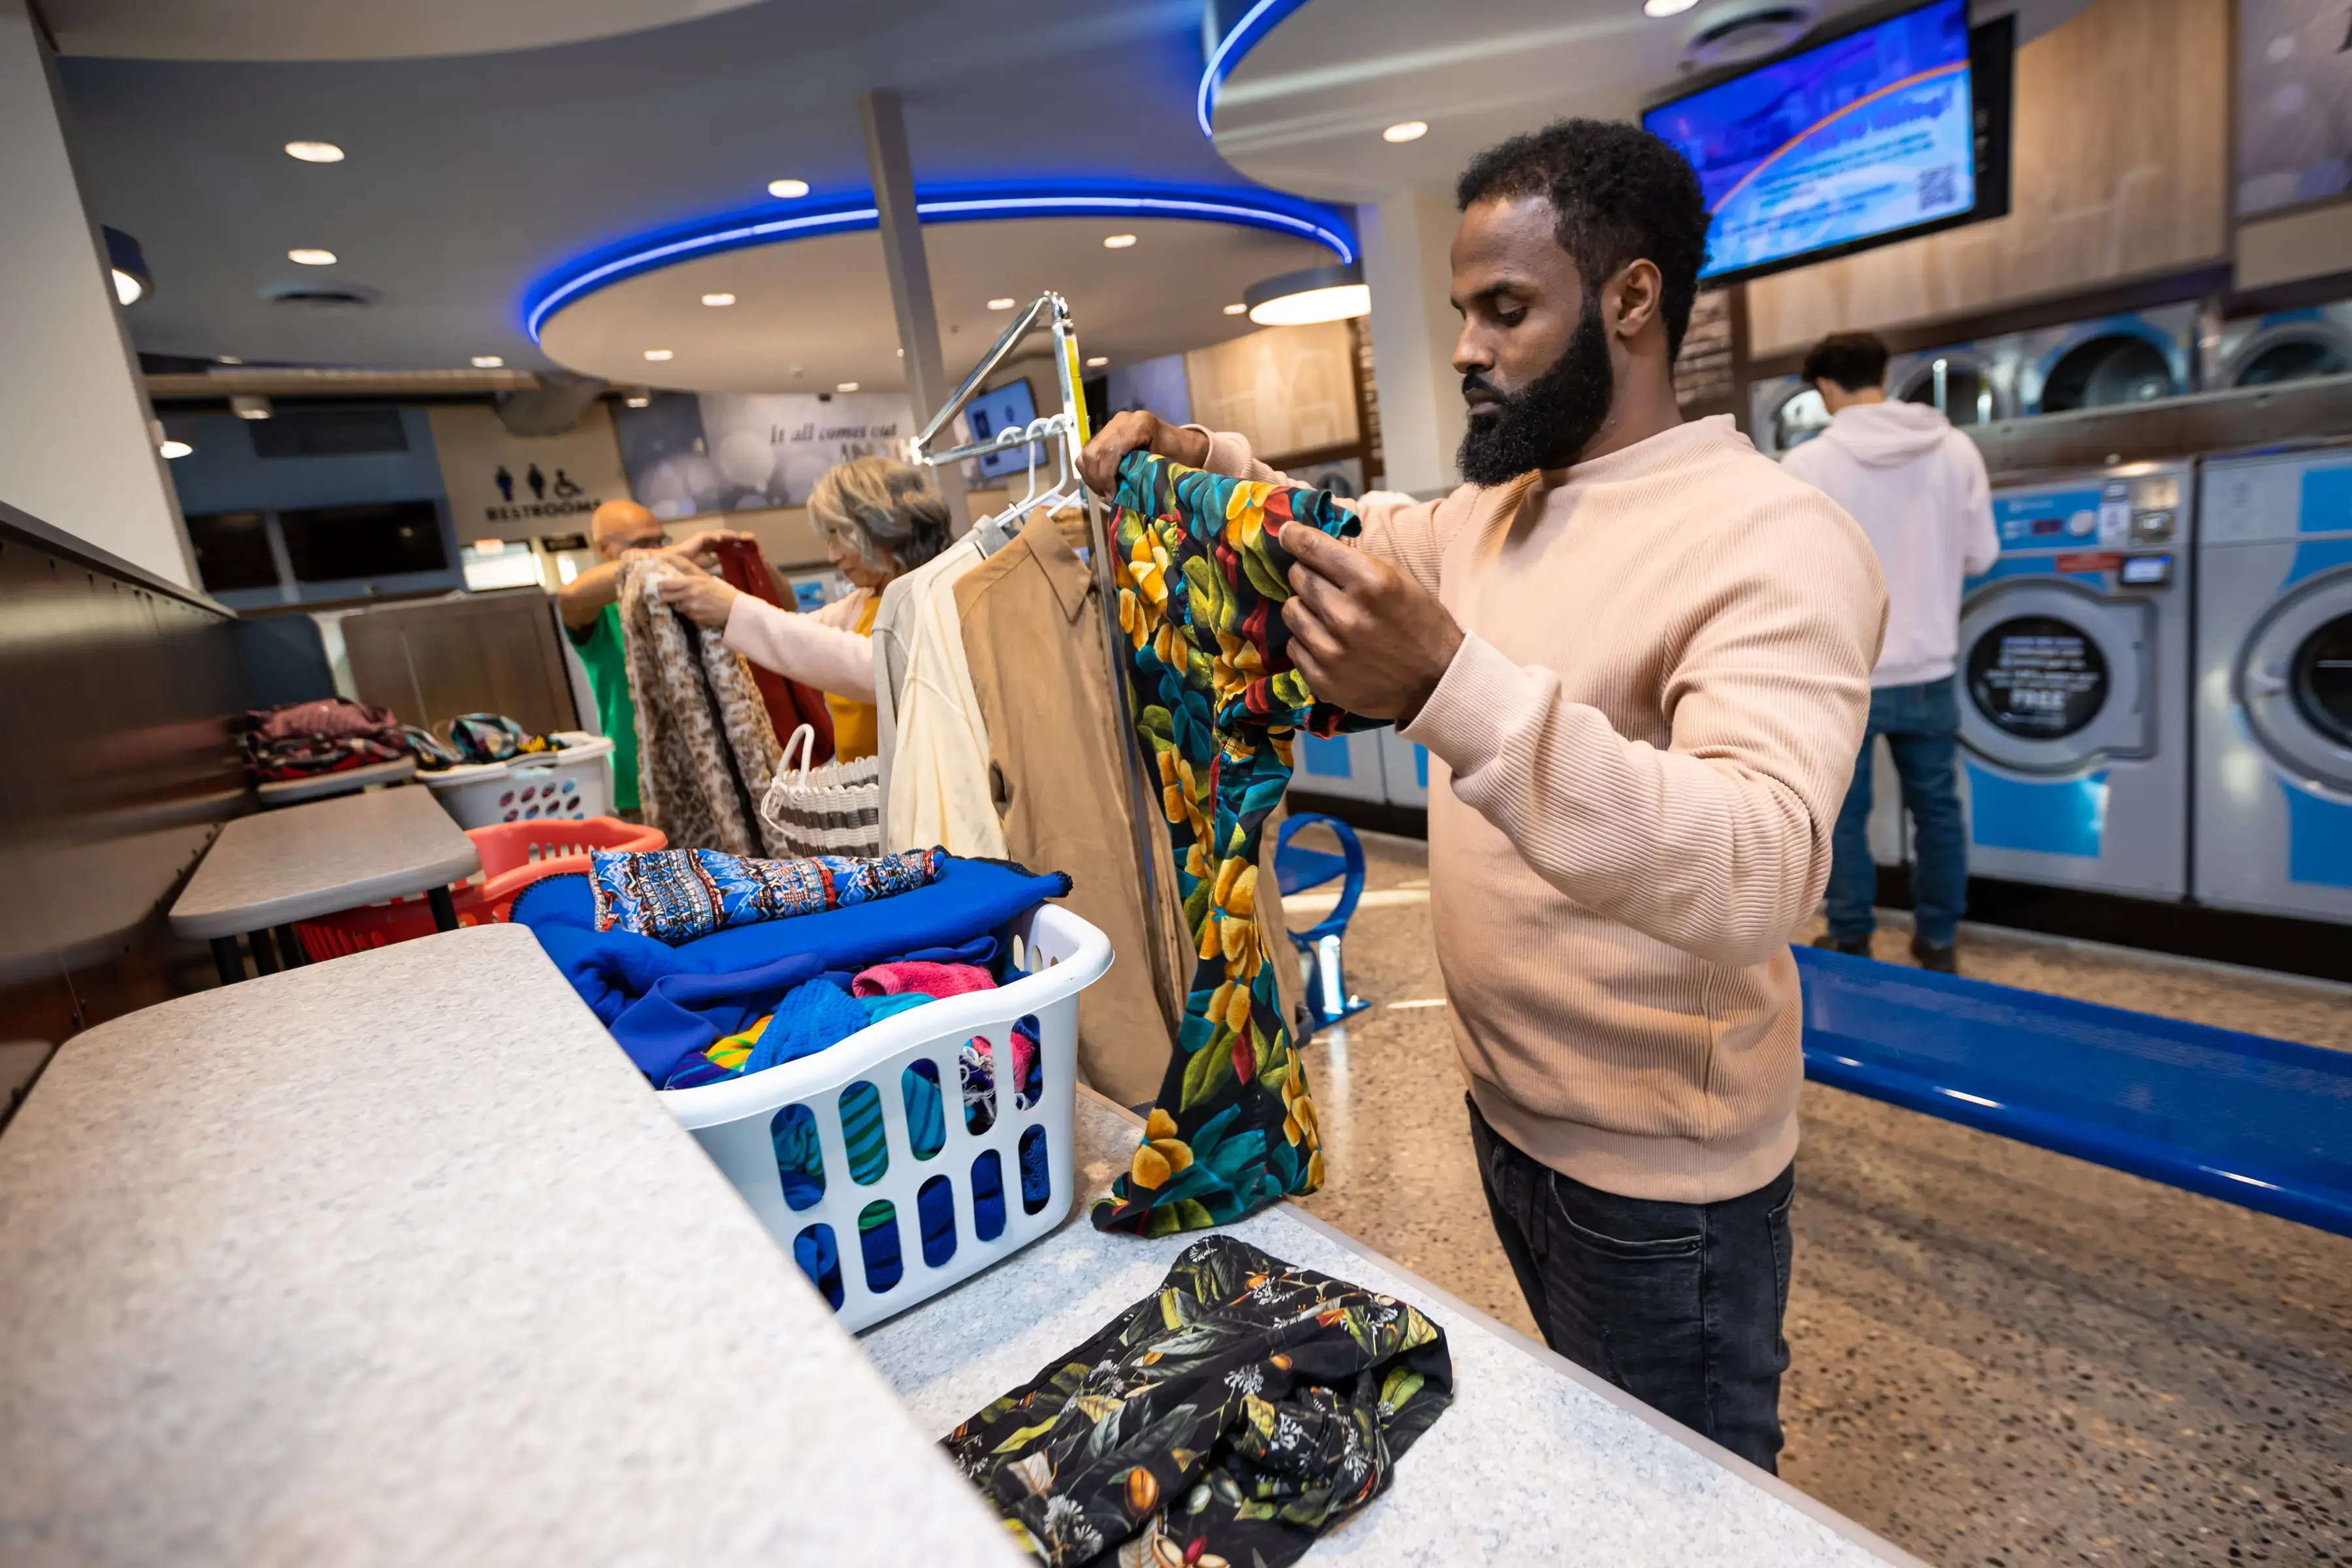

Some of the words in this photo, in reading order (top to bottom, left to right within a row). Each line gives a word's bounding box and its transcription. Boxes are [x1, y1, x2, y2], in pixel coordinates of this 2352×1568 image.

[791, 422, 815, 443] all
[819, 426, 866, 441] comes
[871, 424, 898, 439] out
[2010, 689, 2065, 710] FREE
